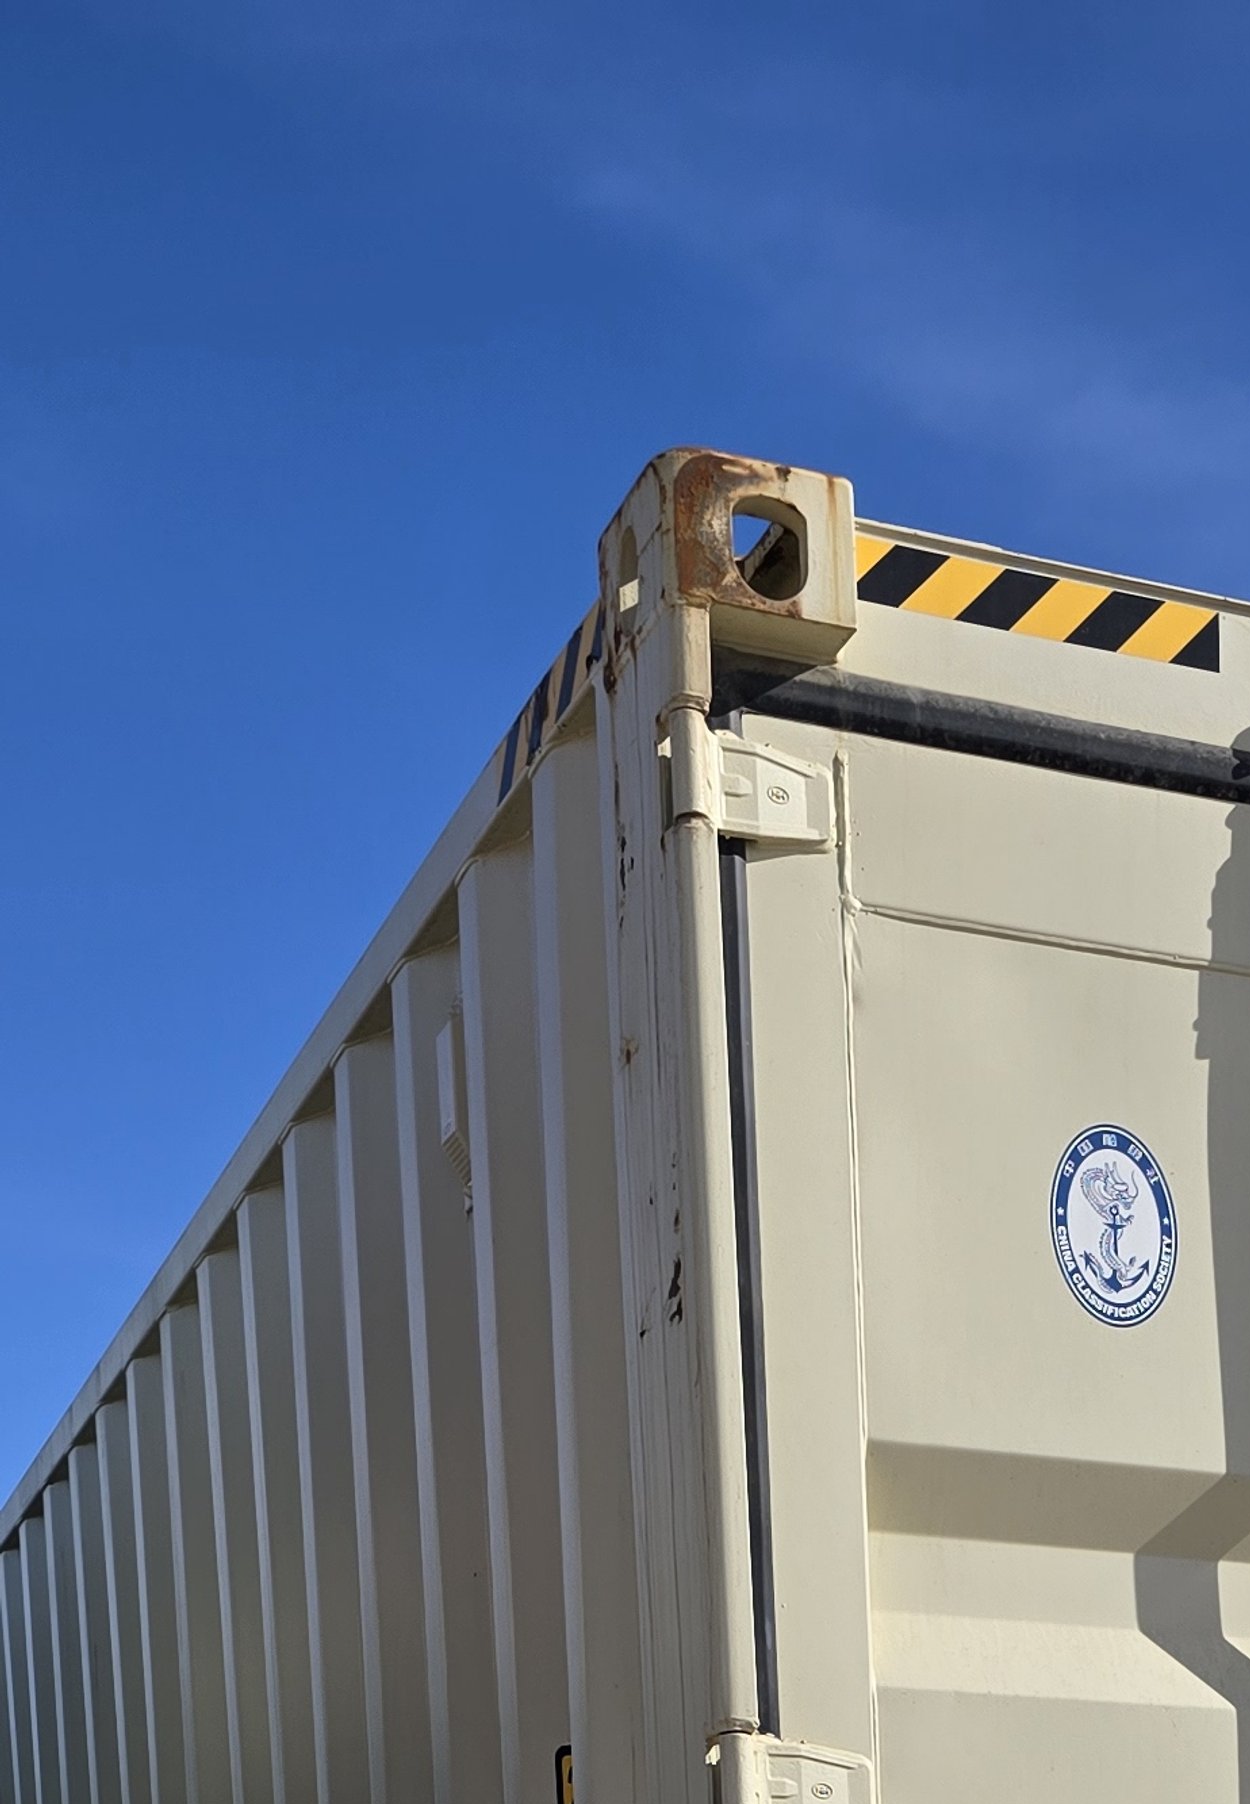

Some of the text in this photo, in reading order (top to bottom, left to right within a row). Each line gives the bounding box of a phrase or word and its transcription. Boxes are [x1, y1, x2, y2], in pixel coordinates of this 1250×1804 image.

[1057, 1225, 1173, 1318] CHINA CLASSIFICATION SOCIETY
